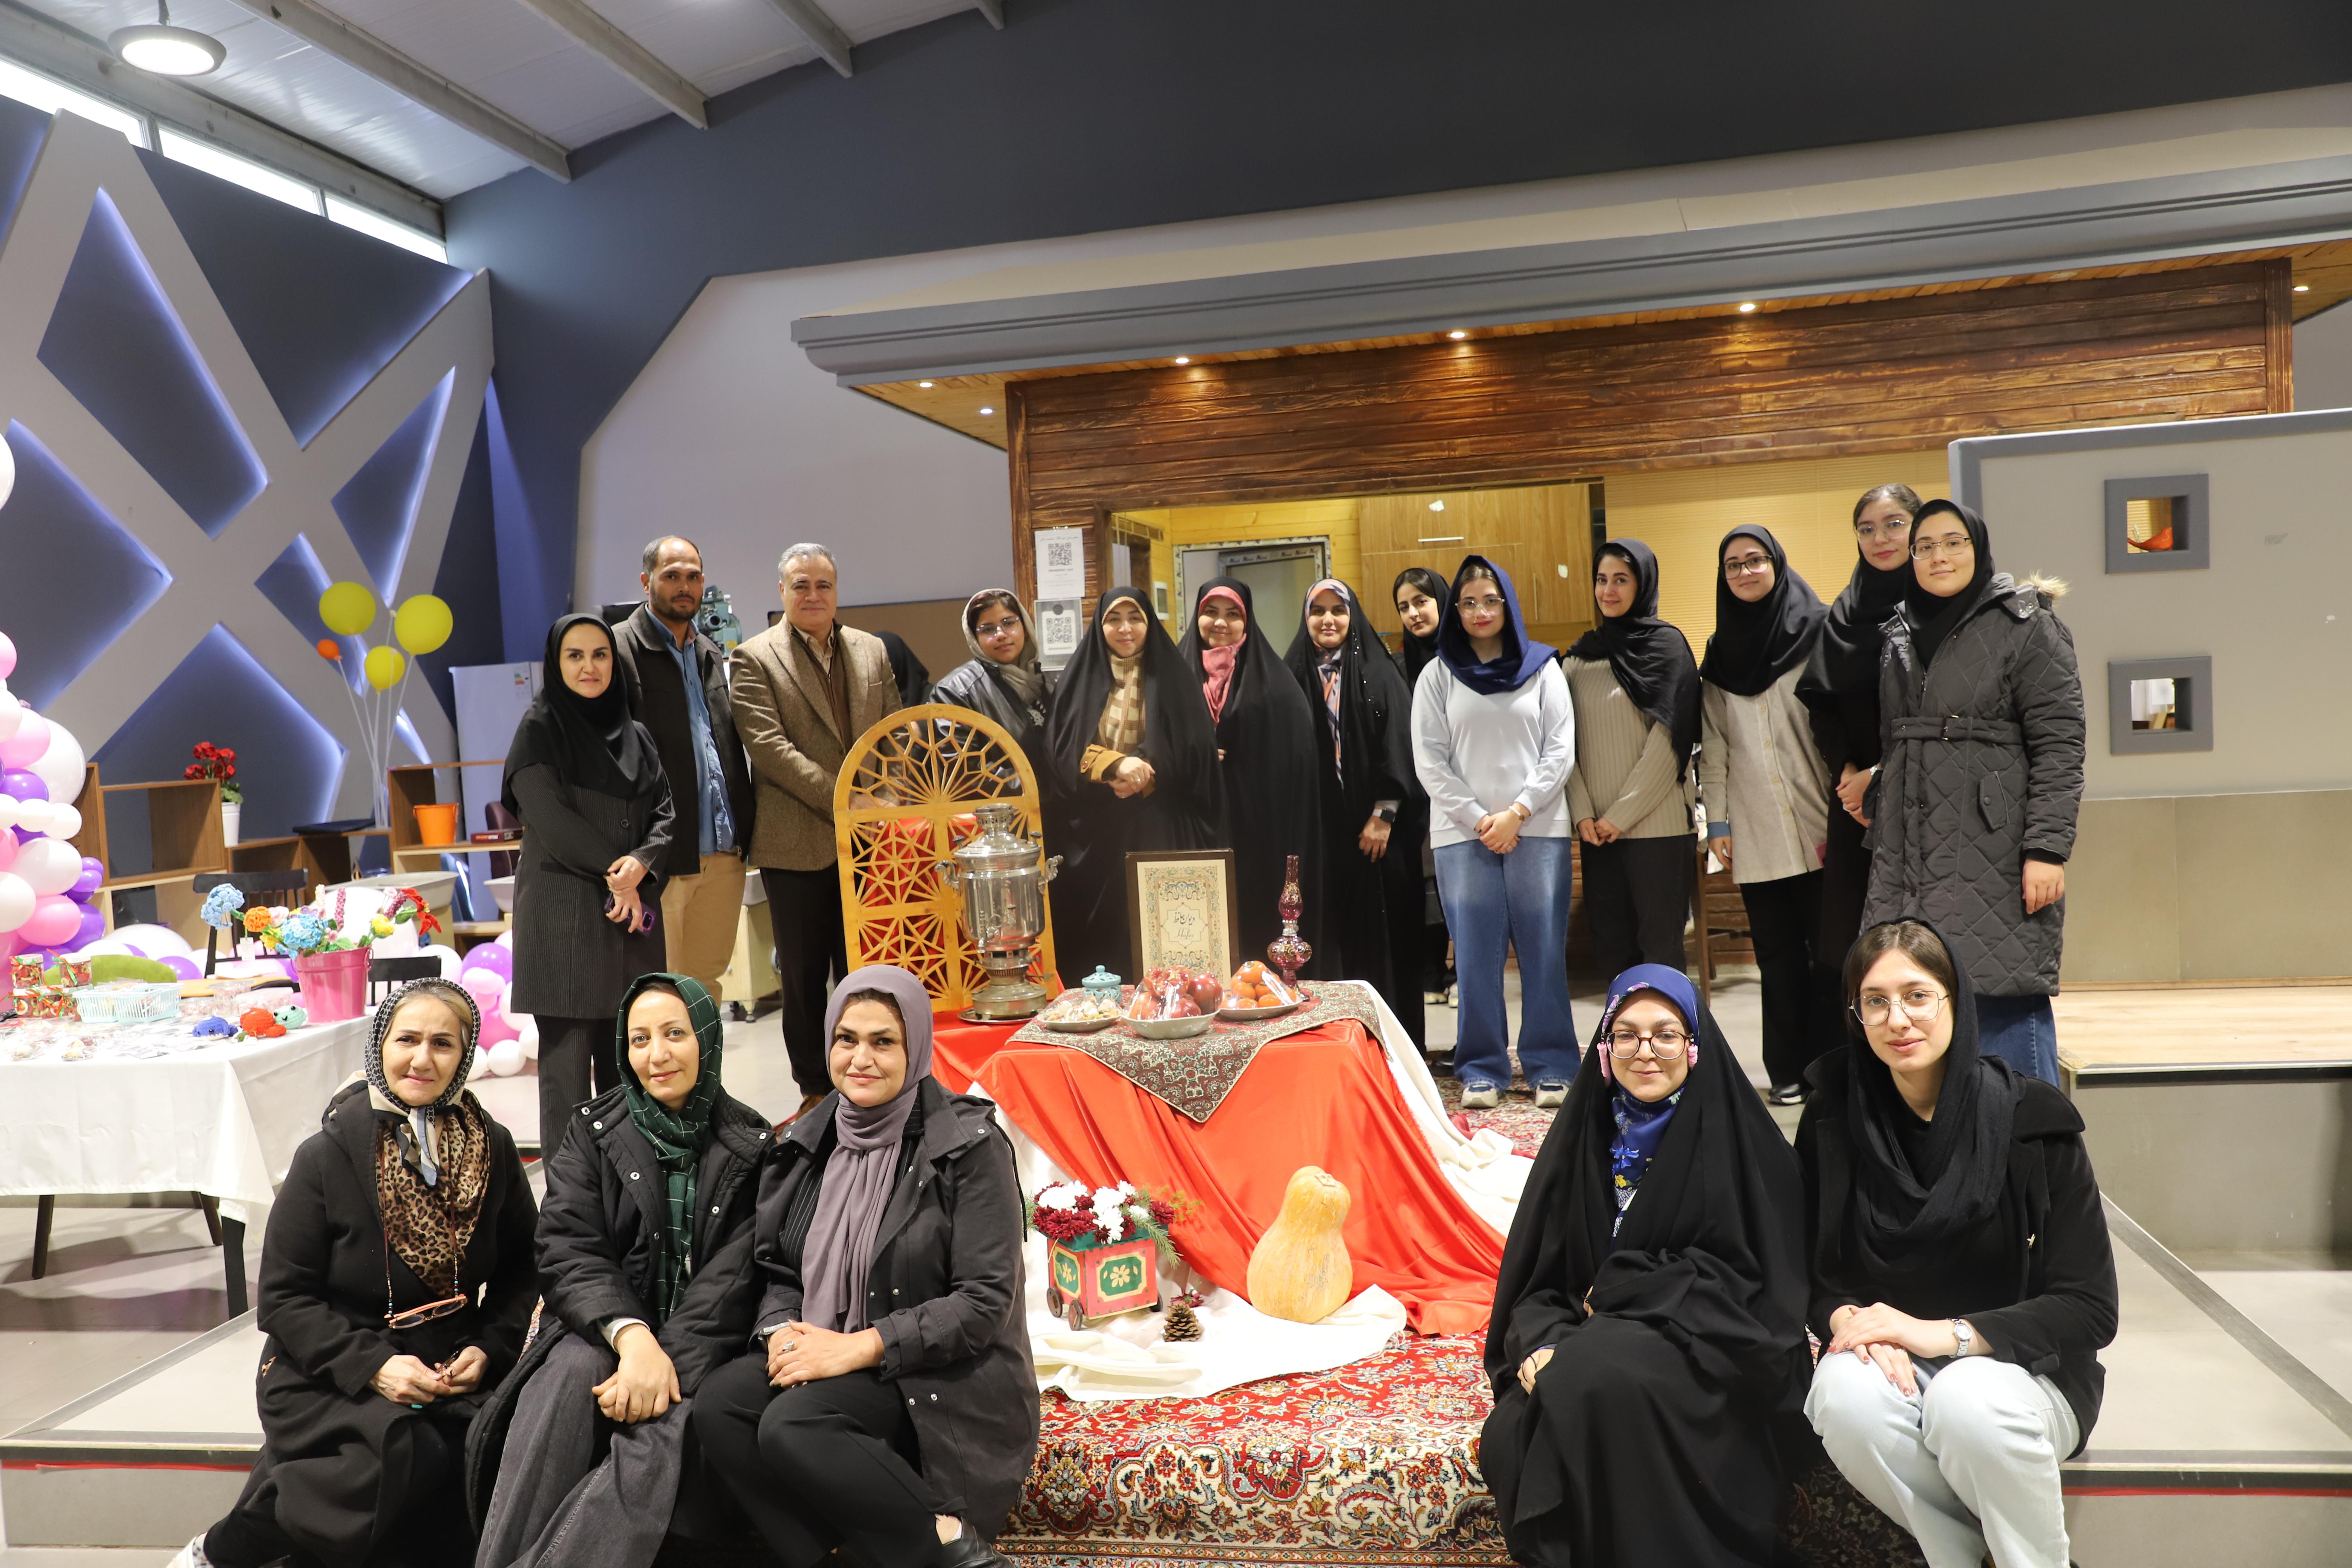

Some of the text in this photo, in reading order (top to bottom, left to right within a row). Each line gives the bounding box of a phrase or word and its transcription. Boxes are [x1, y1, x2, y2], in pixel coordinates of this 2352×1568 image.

[1173, 912, 1195, 925] دیوان حافظ
[1174, 928, 1194, 939] Hafez
